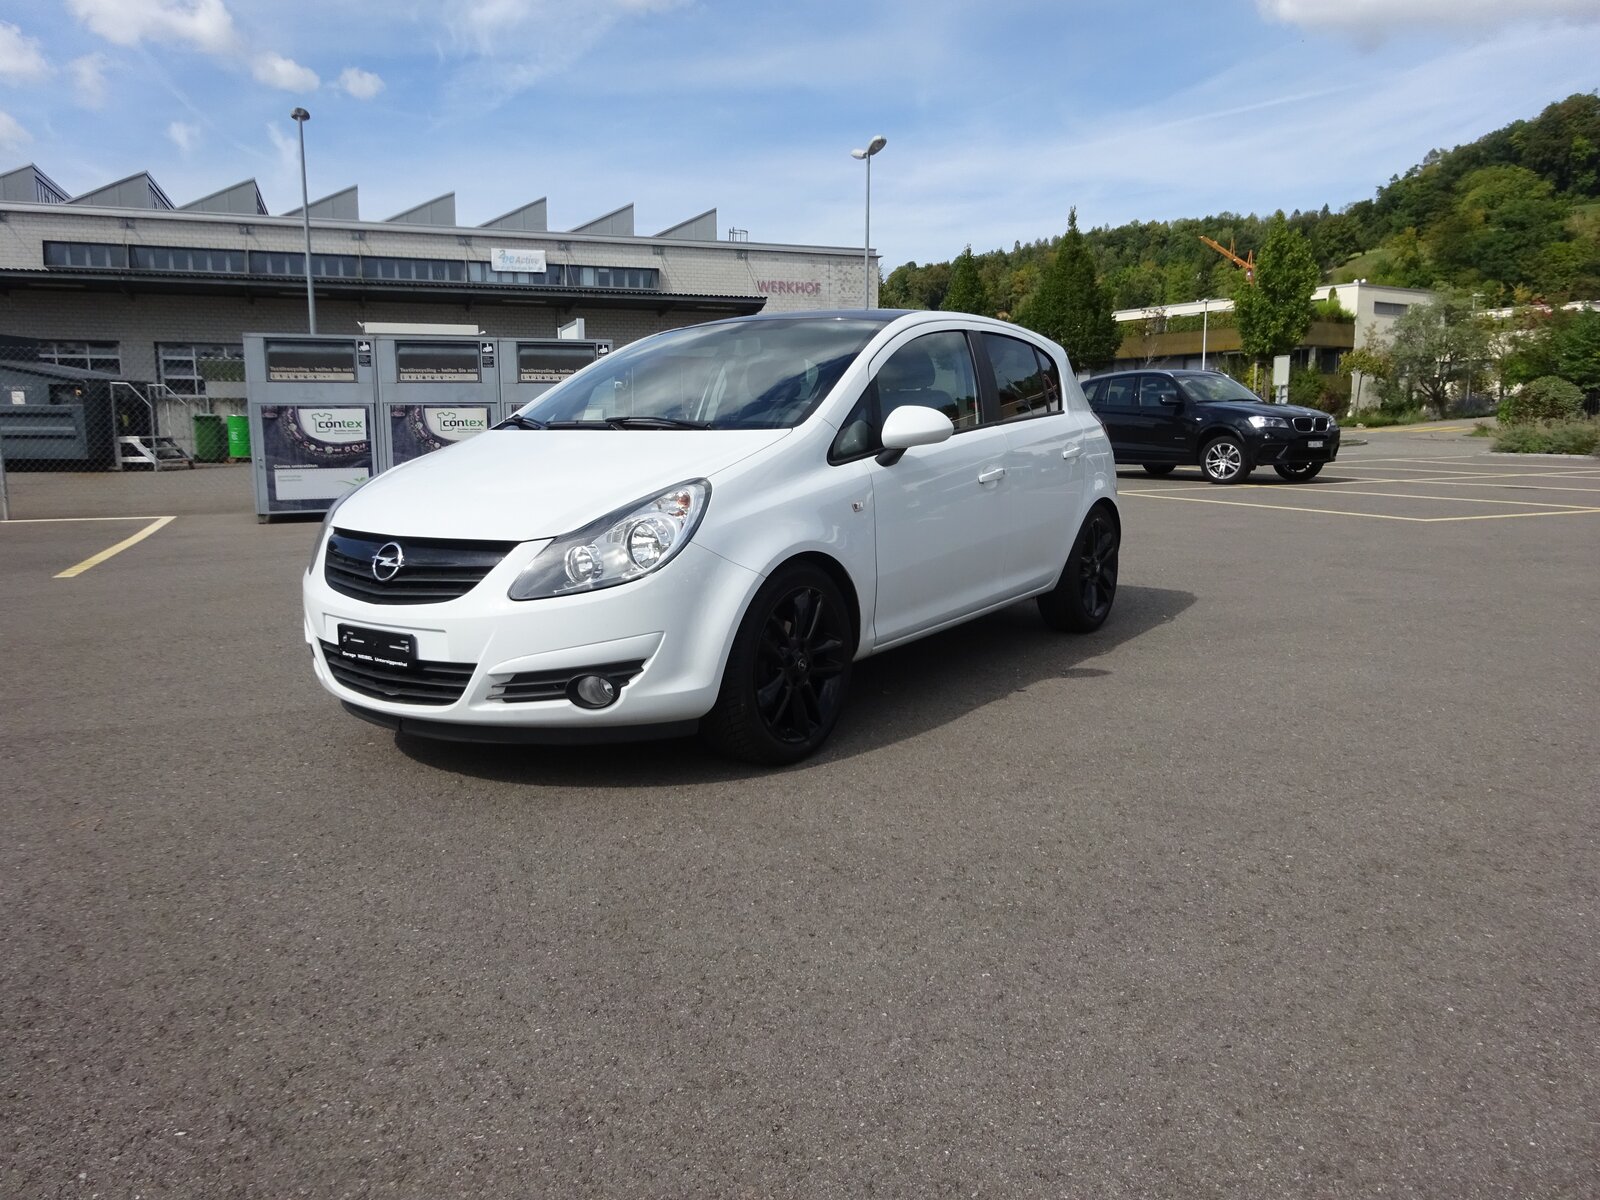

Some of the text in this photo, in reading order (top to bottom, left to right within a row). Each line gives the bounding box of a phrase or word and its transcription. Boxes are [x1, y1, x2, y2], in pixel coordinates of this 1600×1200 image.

[757, 280, 821, 295] WERKHOF
[318, 420, 363, 429] contex
[442, 419, 484, 427] contex
